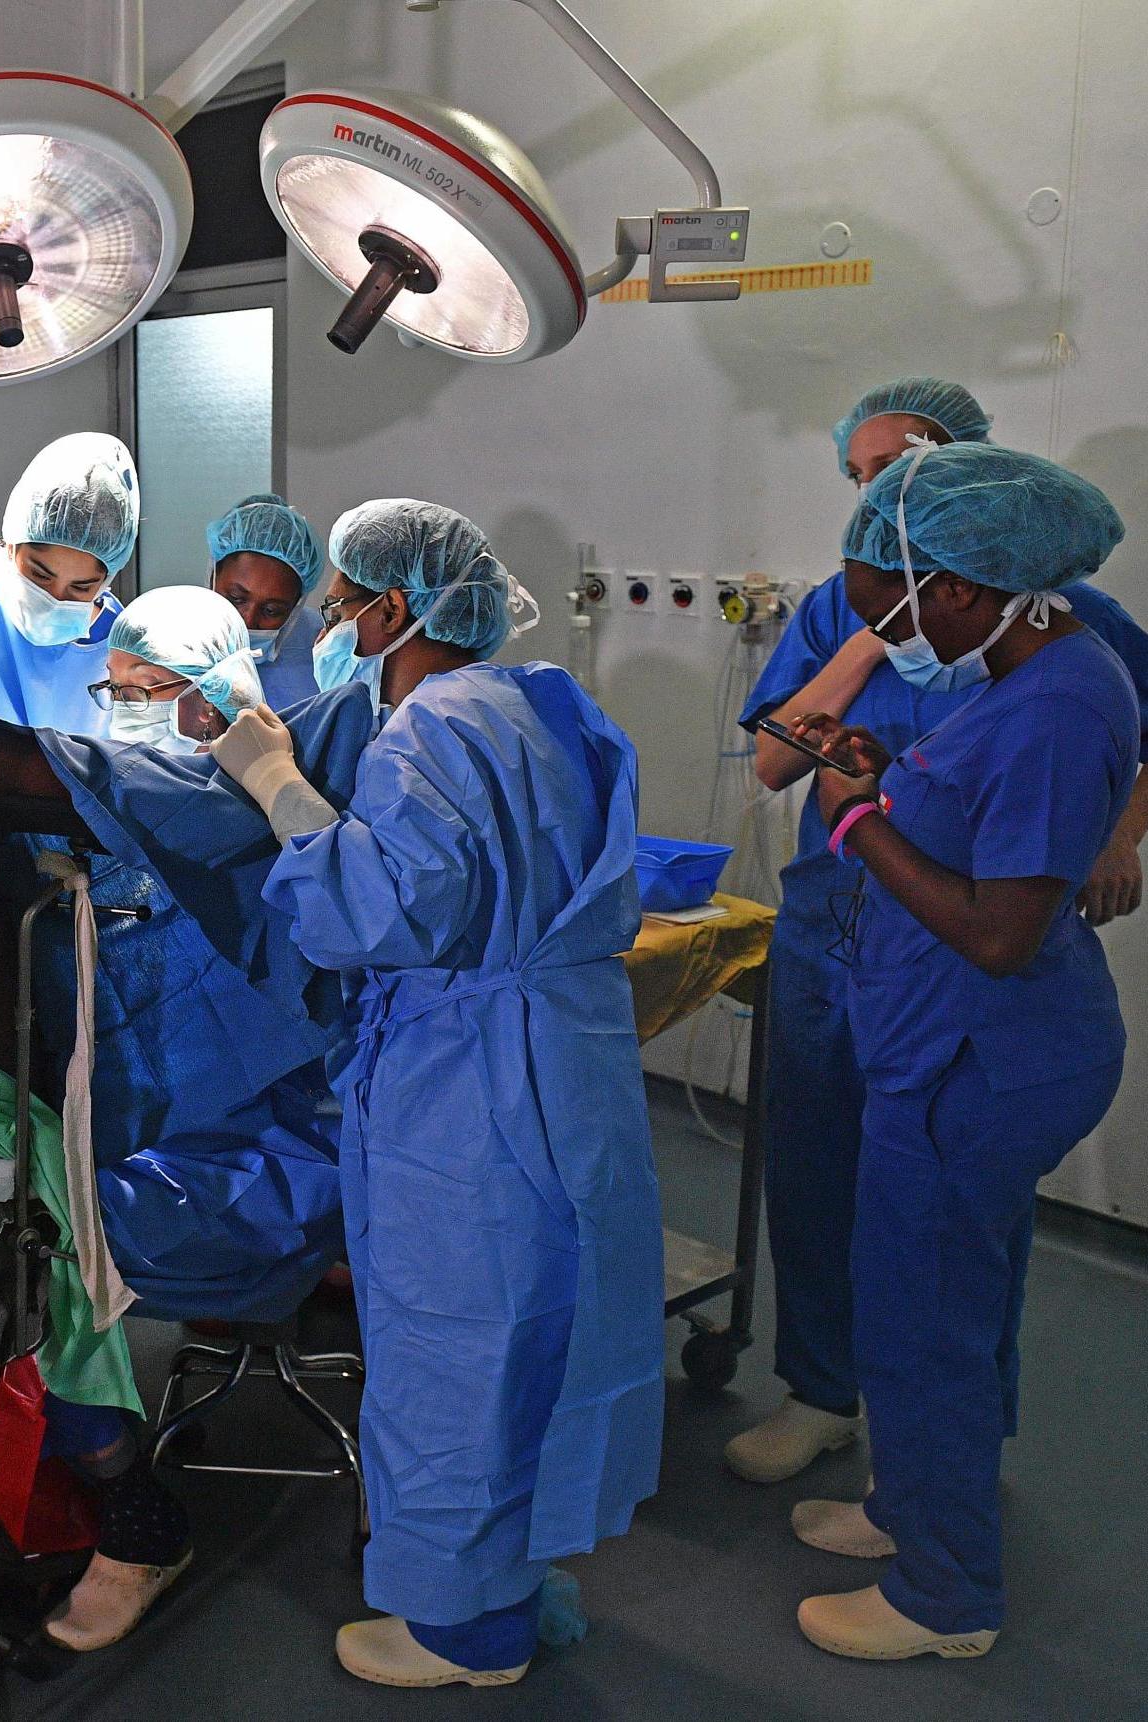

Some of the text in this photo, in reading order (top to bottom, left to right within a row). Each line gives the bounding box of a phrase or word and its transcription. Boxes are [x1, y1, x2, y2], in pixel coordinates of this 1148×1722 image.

[334, 124, 402, 161] martin
[403, 152, 423, 175] ML
[662, 215, 702, 225] martin
